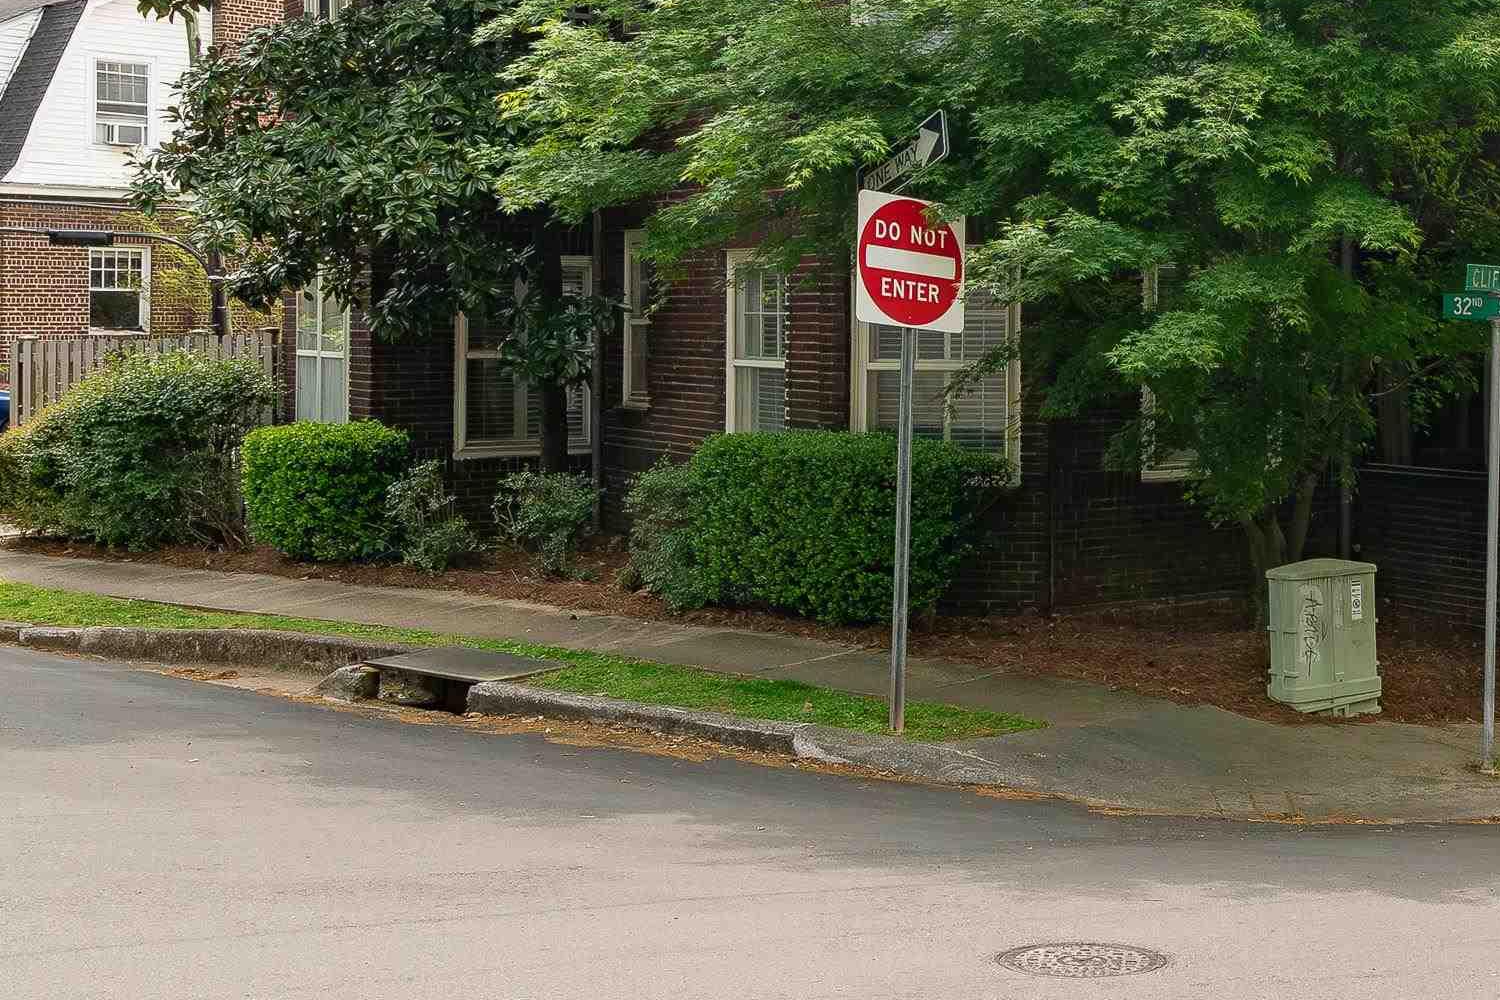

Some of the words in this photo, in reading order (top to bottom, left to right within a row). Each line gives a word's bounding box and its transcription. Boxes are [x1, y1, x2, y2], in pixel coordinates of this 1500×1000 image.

[875, 219, 900, 240] DO
[910, 226, 948, 249] NOT
[881, 276, 940, 304] ENTER
